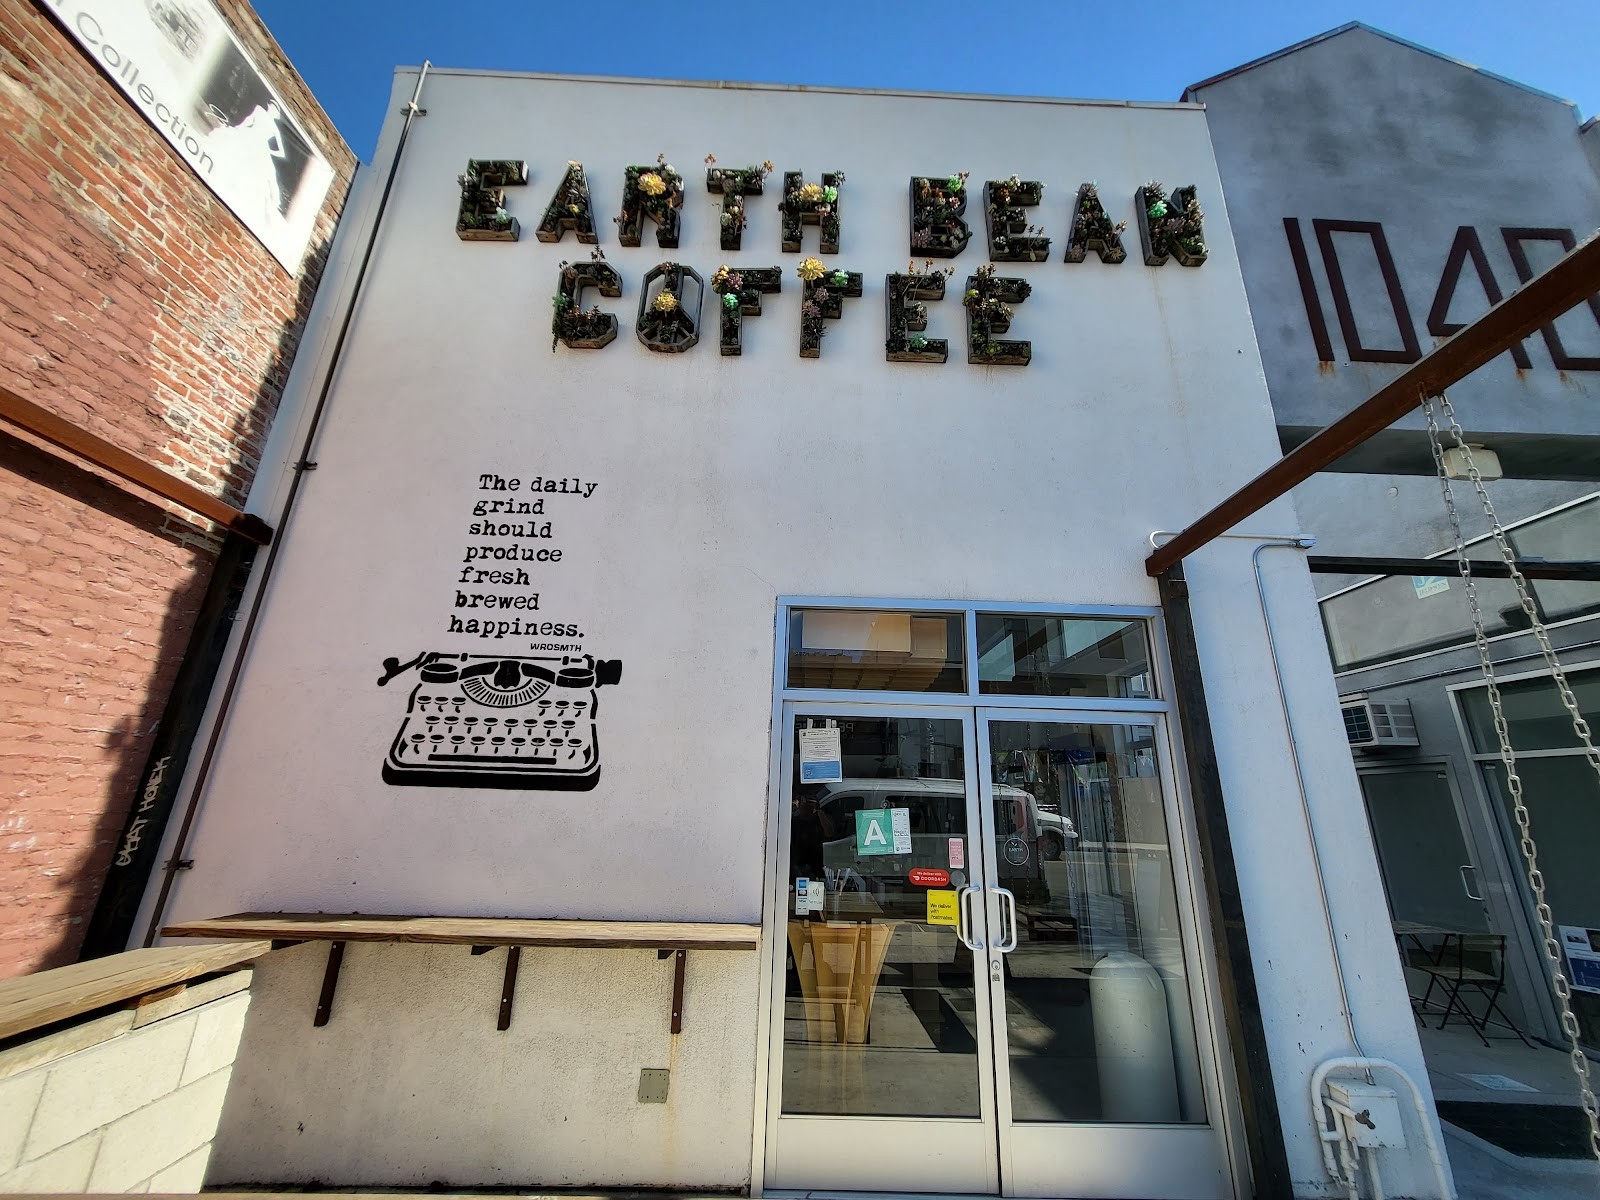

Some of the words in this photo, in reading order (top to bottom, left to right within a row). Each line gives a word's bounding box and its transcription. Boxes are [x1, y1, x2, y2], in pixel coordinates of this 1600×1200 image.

[76, 12, 214, 174] Collection
[456, 156, 842, 253] EARTH
[908, 173, 1208, 267] BEAN
[553, 257, 1033, 366] COFFEE
[479, 474, 521, 491] The
[530, 477, 598, 498] daily
[472, 498, 545, 516] grind
[468, 520, 552, 538] should
[463, 544, 562, 562] produce
[458, 566, 530, 585] fresh
[454, 590, 540, 610] brewed
[447, 615, 585, 638] happiness.
[863, 819, 887, 846] A
